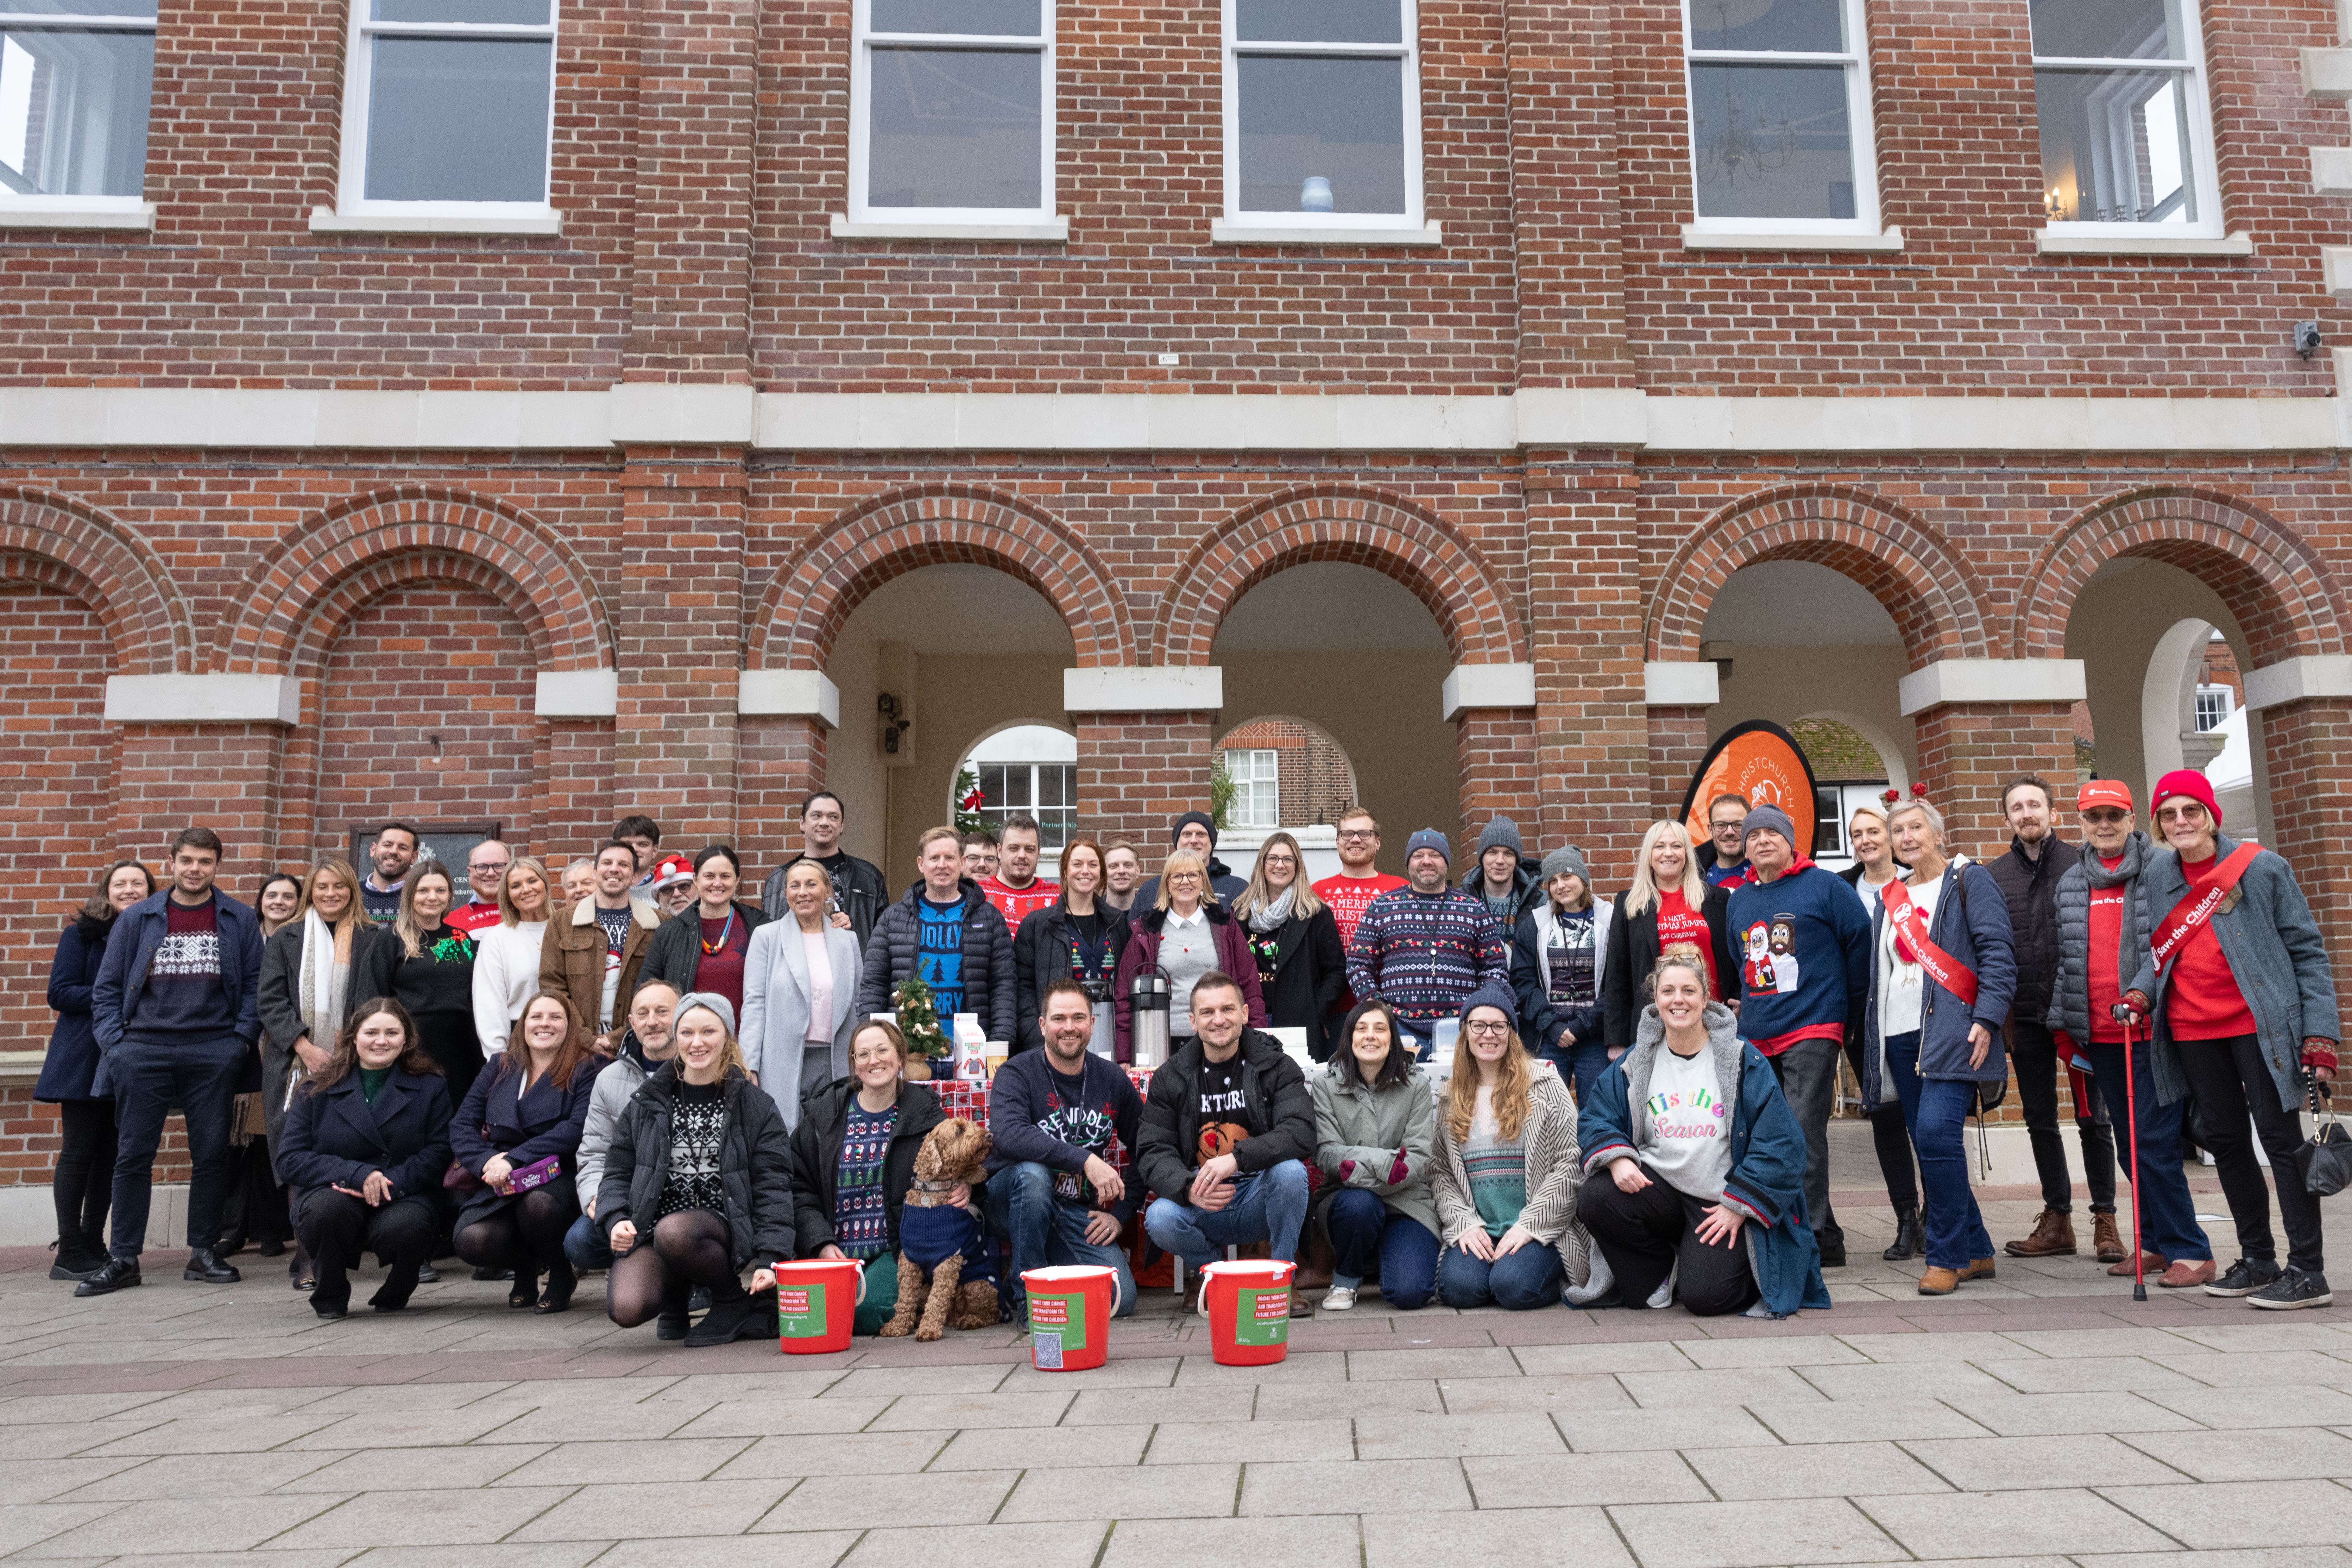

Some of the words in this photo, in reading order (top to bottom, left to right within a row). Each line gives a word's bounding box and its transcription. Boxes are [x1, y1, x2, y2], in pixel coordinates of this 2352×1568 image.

[1738, 757, 1794, 807] HRISTCHURCH
[1041, 821, 1077, 830] Partnerhip
[1668, 913, 1686, 922] HATE
[2157, 938, 2174, 957] Save
[2172, 925, 2188, 939] the
[2186, 887, 2220, 924] Children
[920, 923, 962, 949] JOLLY
[1901, 921, 1912, 940] Save
[1918, 949, 1948, 980] Children
[1689, 1088, 1724, 1117] the
[1653, 1117, 1717, 1139] Season
[522, 1174, 541, 1184] Quality
[525, 1180, 541, 1188] Street
